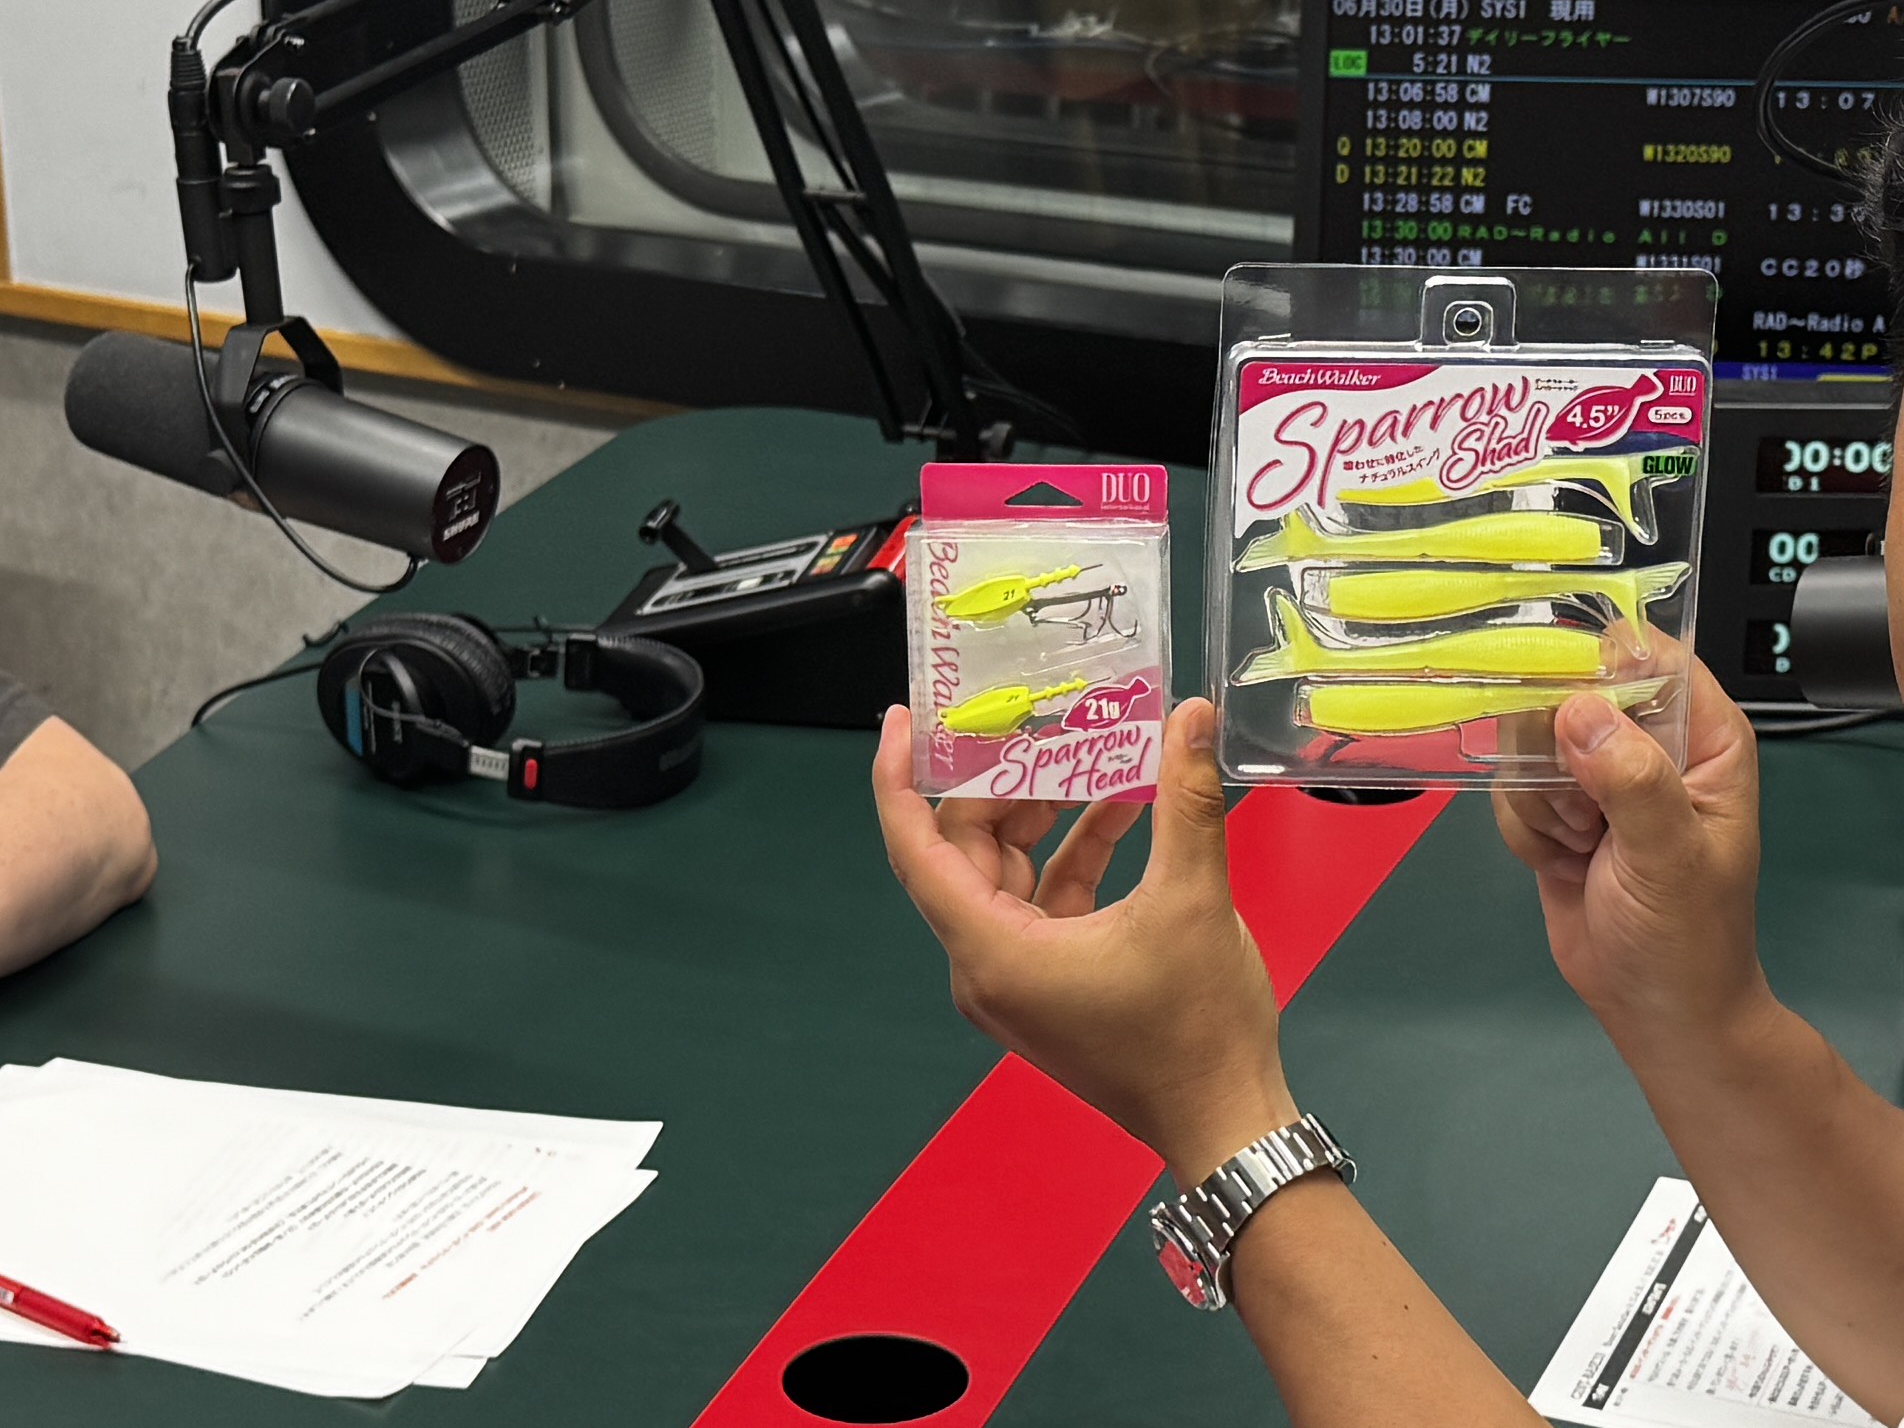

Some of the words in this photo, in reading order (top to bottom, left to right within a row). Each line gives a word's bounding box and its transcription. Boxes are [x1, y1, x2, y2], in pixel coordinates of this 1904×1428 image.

[1369, 25, 1463, 46] 13:01:37
[1413, 53, 1457, 73] 5:21
[1466, 54, 1492, 75] N2
[1367, 82, 1459, 102] 13:06:58
[1465, 83, 1491, 103] CM
[1366, 110, 1458, 130] 13:08:00
[1463, 112, 1489, 131] N2
[1365, 137, 1457, 159] 13:20:00
[1462, 139, 1488, 159] CM
[1364, 165, 1456, 186] 13:21:22
[1461, 167, 1487, 187] N2
[1362, 193, 1454, 214] 13:28:58
[1460, 194, 1486, 214] CM
[1506, 193, 1533, 215] FC
[1362, 220, 1453, 240] 13:30:00
[1361, 246, 1451, 266] 13:30:00
[1457, 249, 1484, 266] CM
[1258, 368, 1315, 385] Beach
[1317, 369, 1382, 386] Walker
[1669, 375, 1697, 395] DUO
[1247, 376, 1532, 511] Sparrow
[1443, 403, 1546, 490] Shad
[1343, 445, 1424, 471] 喰わせに特化した
[1359, 448, 1441, 483] ナチュラルスイング
[1642, 455, 1694, 475] GLOW
[1101, 472, 1151, 503] DUO
[1003, 589, 1016, 602] 21
[990, 724, 1141, 798] Sparrow
[1058, 737, 1153, 798] Head
